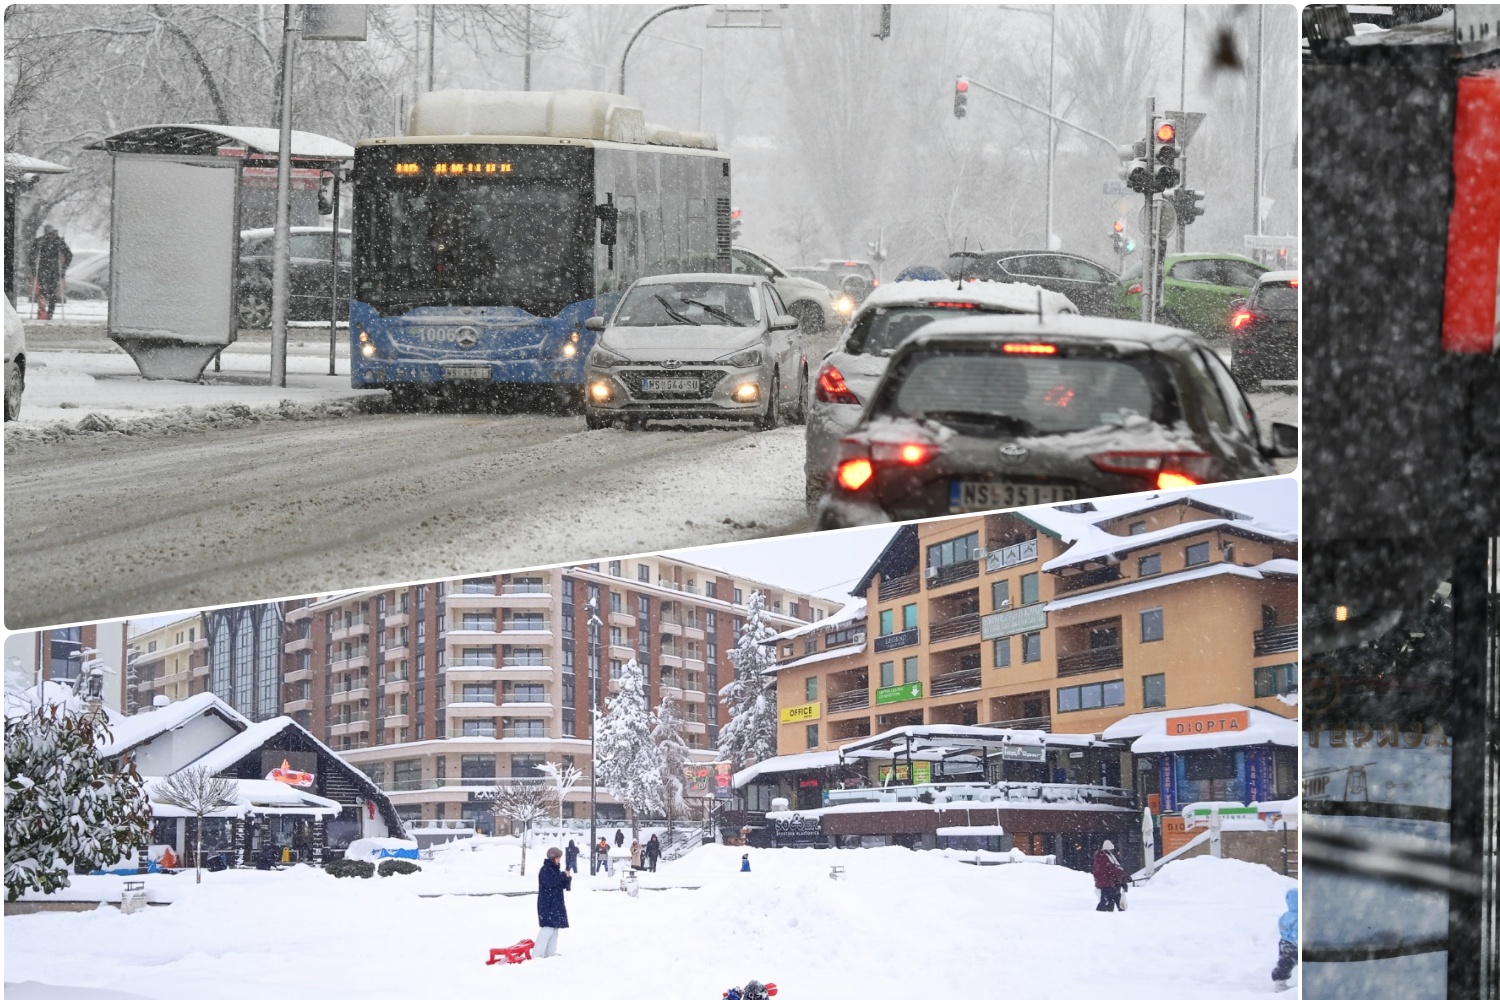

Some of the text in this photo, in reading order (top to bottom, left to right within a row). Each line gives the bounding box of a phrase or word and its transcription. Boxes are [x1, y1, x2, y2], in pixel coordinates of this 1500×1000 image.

[420, 327, 456, 342] 1006
[965, 486, 988, 504] NS
[789, 706, 812, 717] OFFICE
[1176, 719, 1238, 734] DIOPTA
